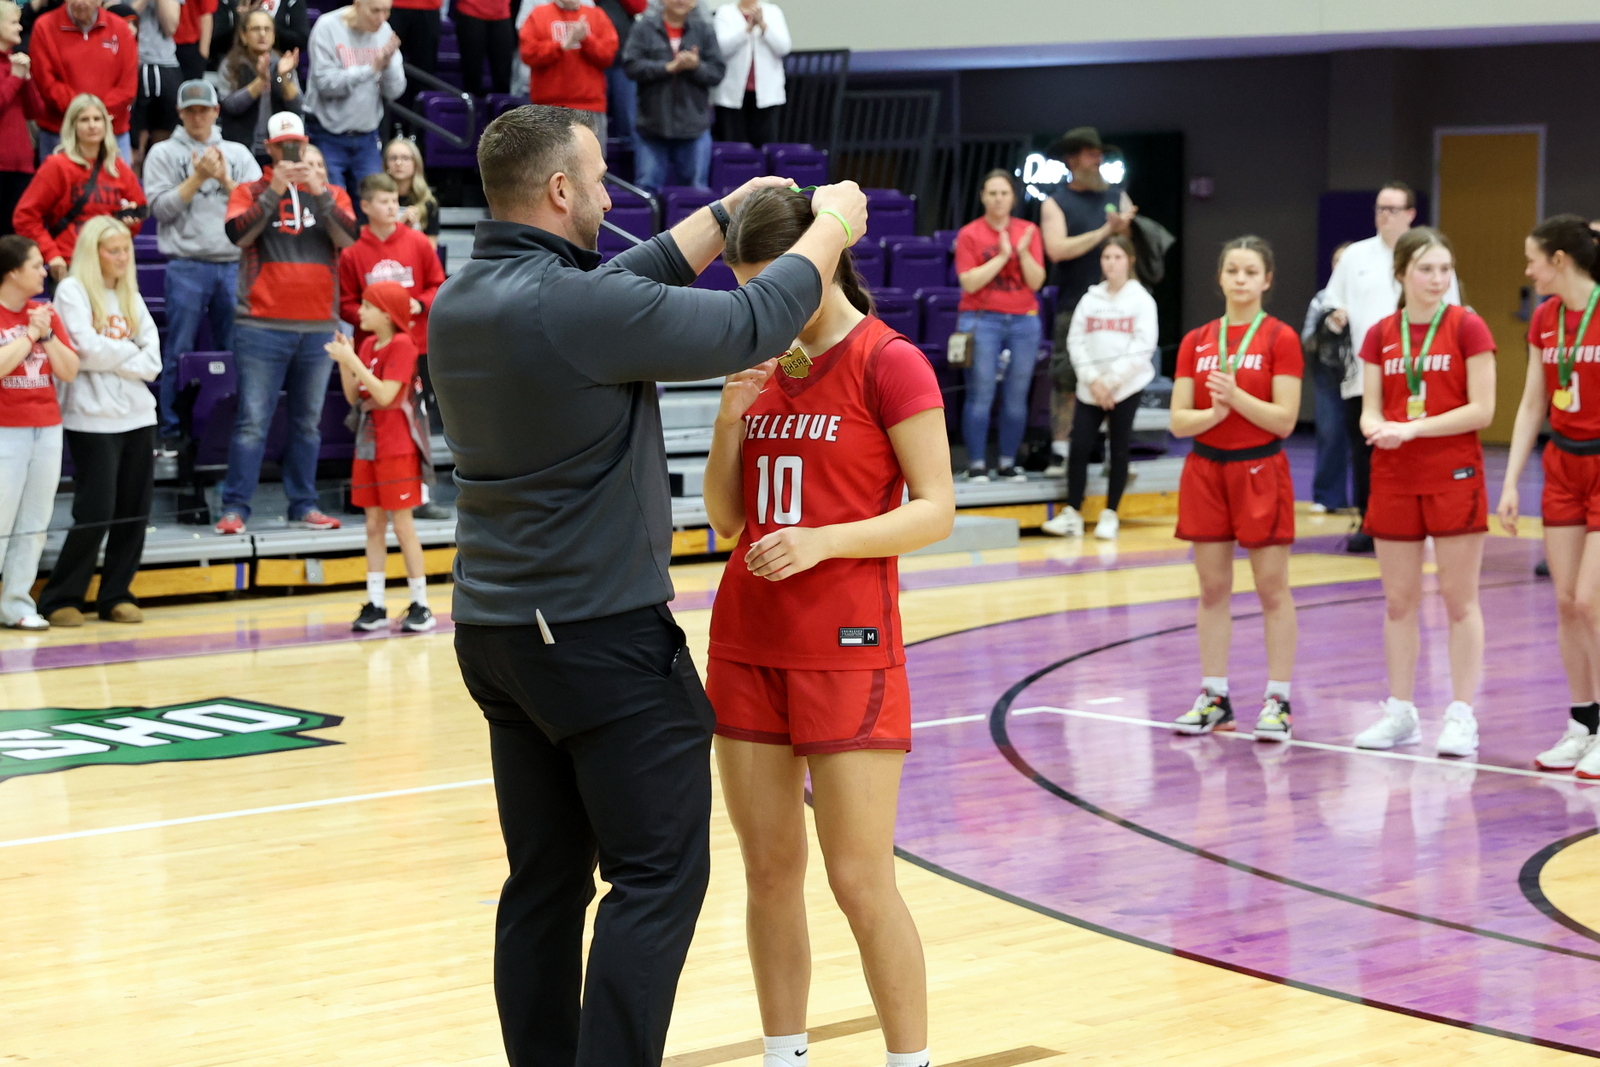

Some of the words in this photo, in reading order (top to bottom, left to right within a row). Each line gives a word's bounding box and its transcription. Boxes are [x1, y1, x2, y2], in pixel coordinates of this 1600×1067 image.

[783, 357, 808, 374] OHSAA
[1195, 354, 1263, 373] BELEVUE
[1384, 354, 1451, 376] BELVUE
[756, 455, 803, 525] 10
[867, 632, 875, 641] M
